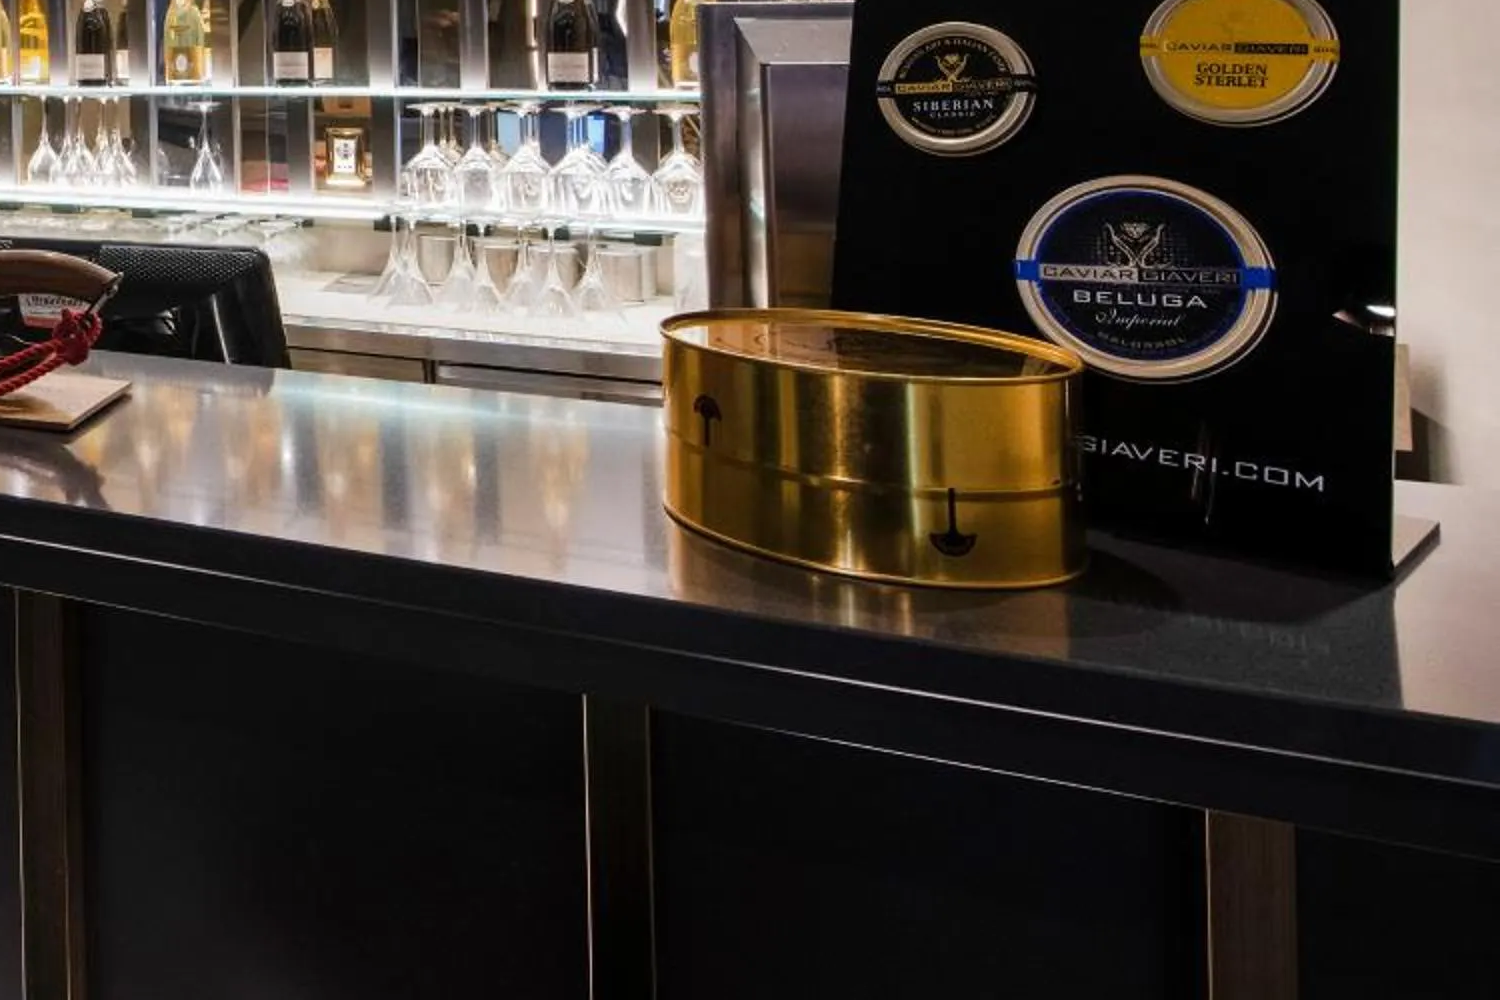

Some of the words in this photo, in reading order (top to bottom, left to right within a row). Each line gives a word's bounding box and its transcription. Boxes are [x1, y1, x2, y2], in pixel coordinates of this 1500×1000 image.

[1166, 41, 1232, 52] CAVIAR
[1196, 62, 1269, 76] GOLDEN
[1194, 75, 1269, 89] STERLET
[912, 100, 994, 112] SIBERIAN
[1042, 266, 1134, 281] CAVIAR
[1141, 271, 1238, 284] GIAVERI
[1073, 289, 1208, 309] BELUGA
[1094, 308, 1184, 329] Imperial
